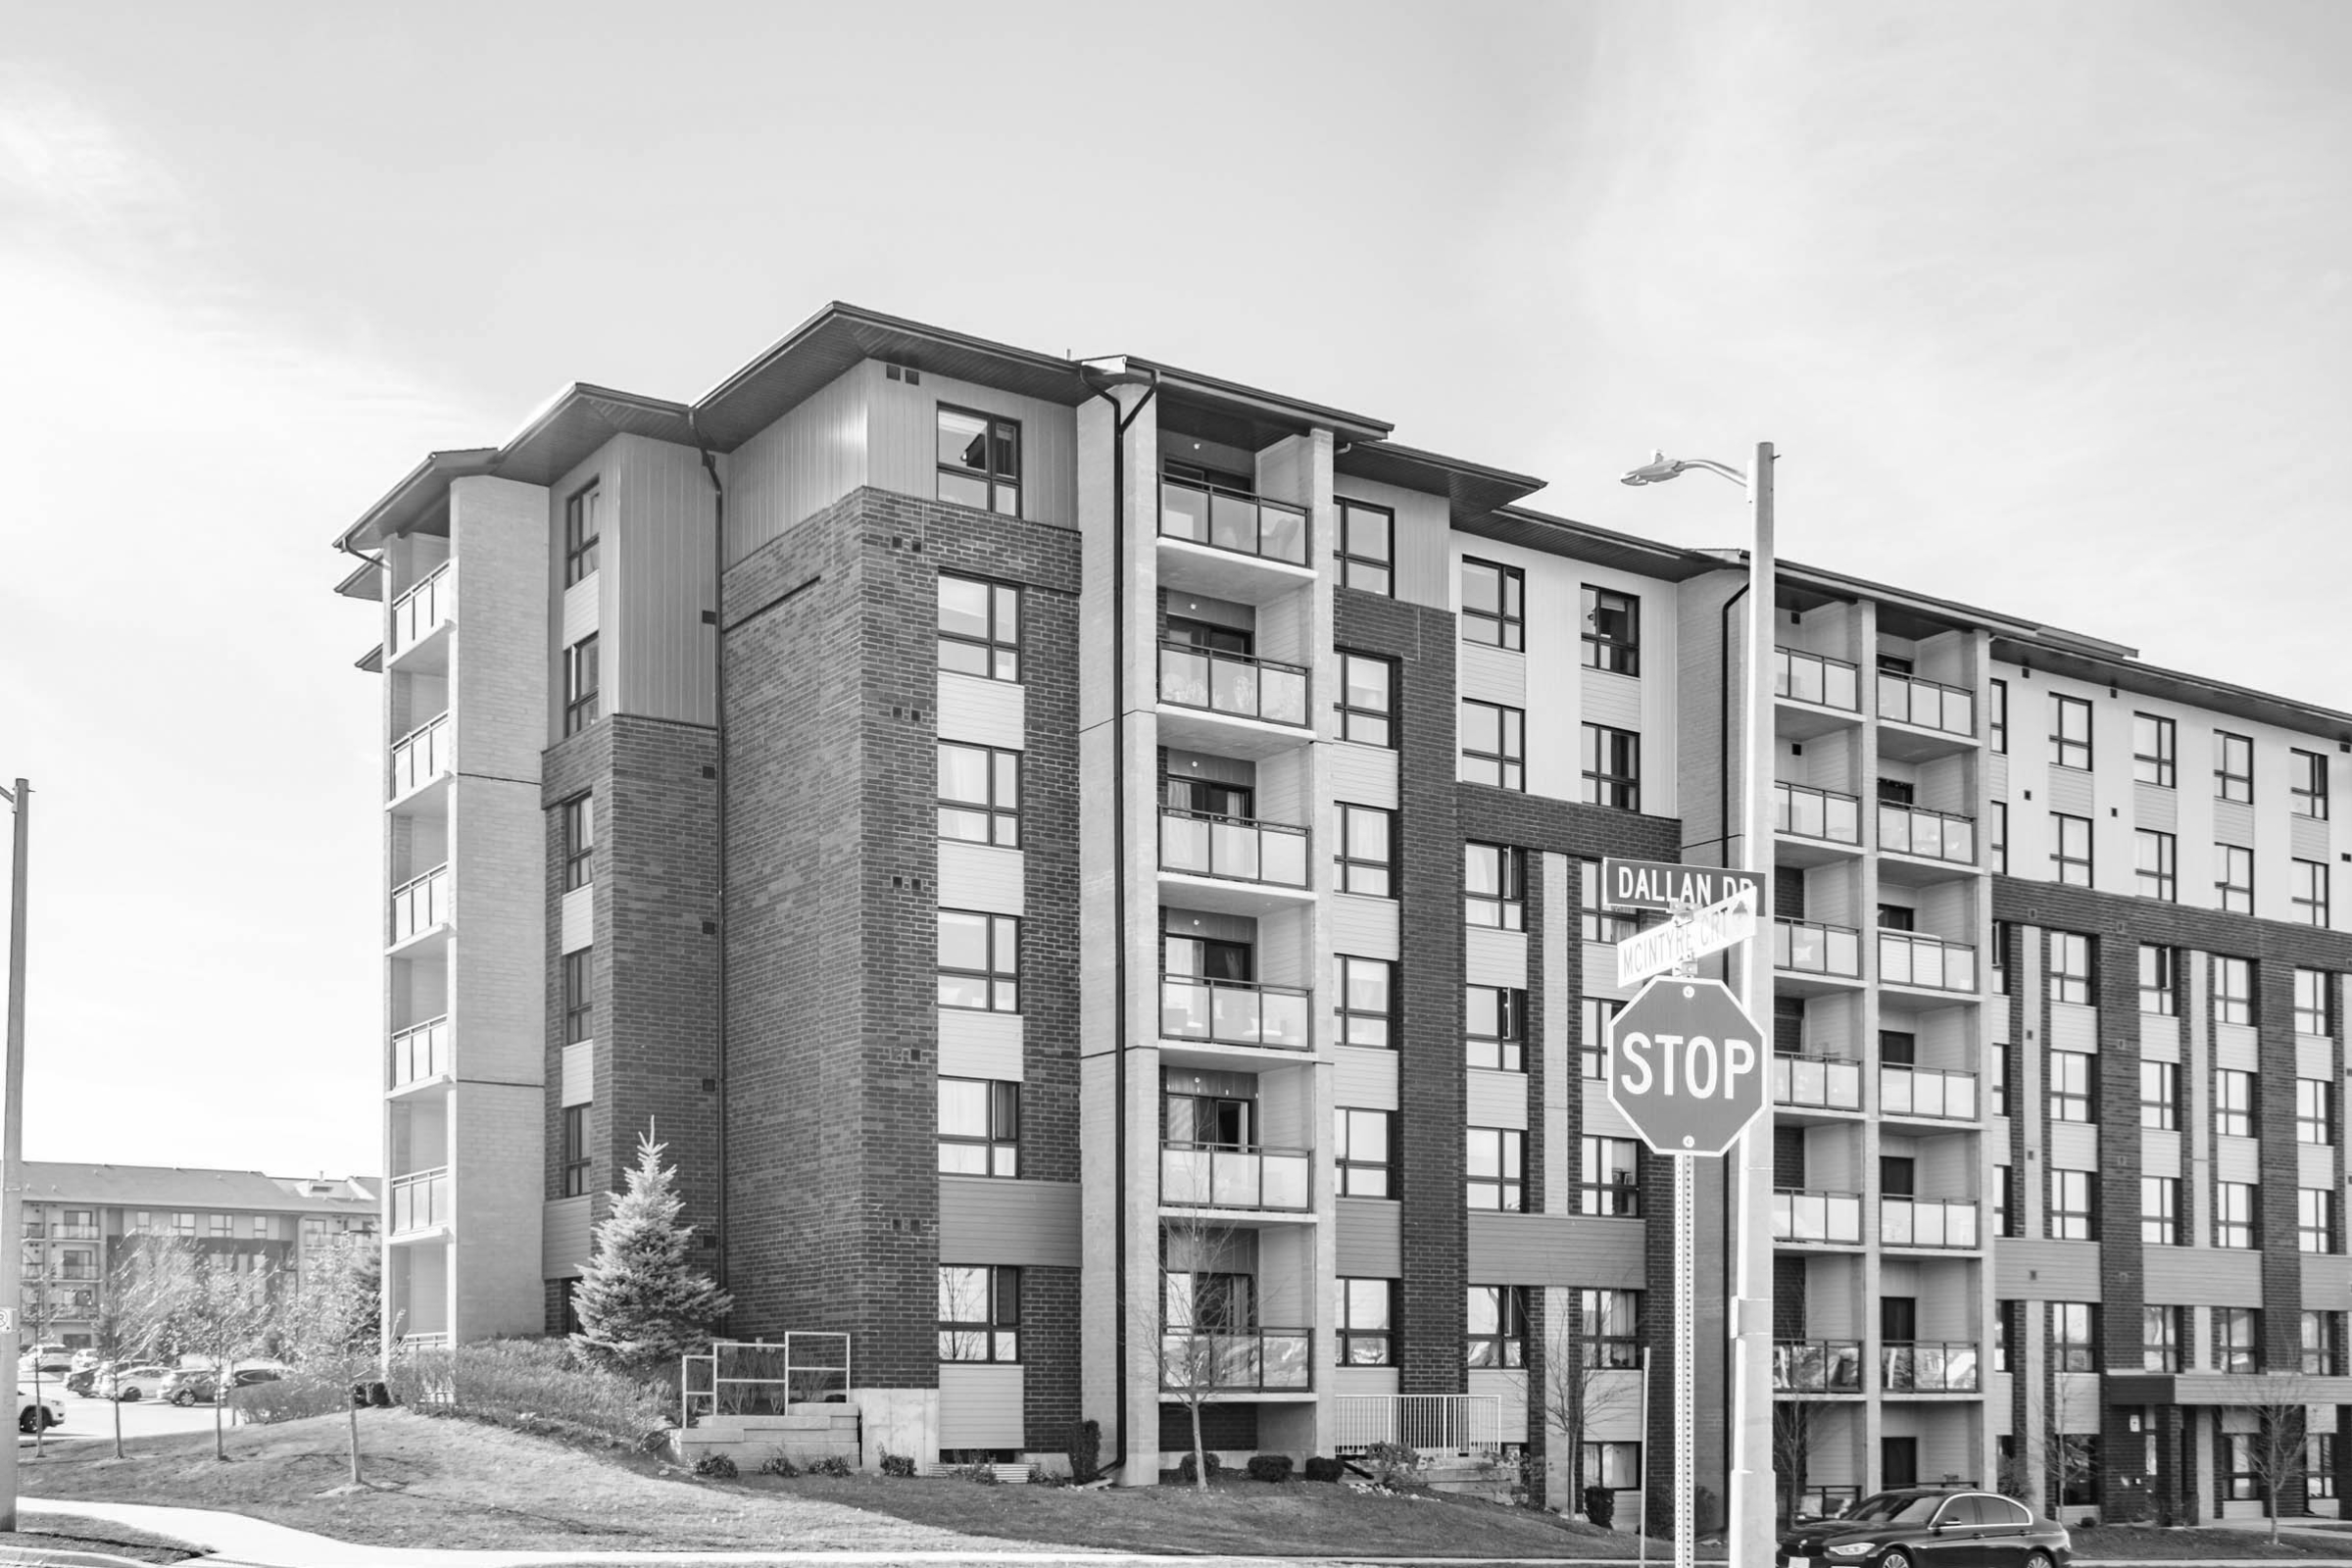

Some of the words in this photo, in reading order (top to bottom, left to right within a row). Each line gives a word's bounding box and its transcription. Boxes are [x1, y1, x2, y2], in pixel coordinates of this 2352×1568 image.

[1618, 866, 1711, 906] DALLAN
[1623, 925, 1694, 978] MCINTYRE
[1700, 906, 1729, 946] CRT
[1621, 1032, 1755, 1099] STOP
